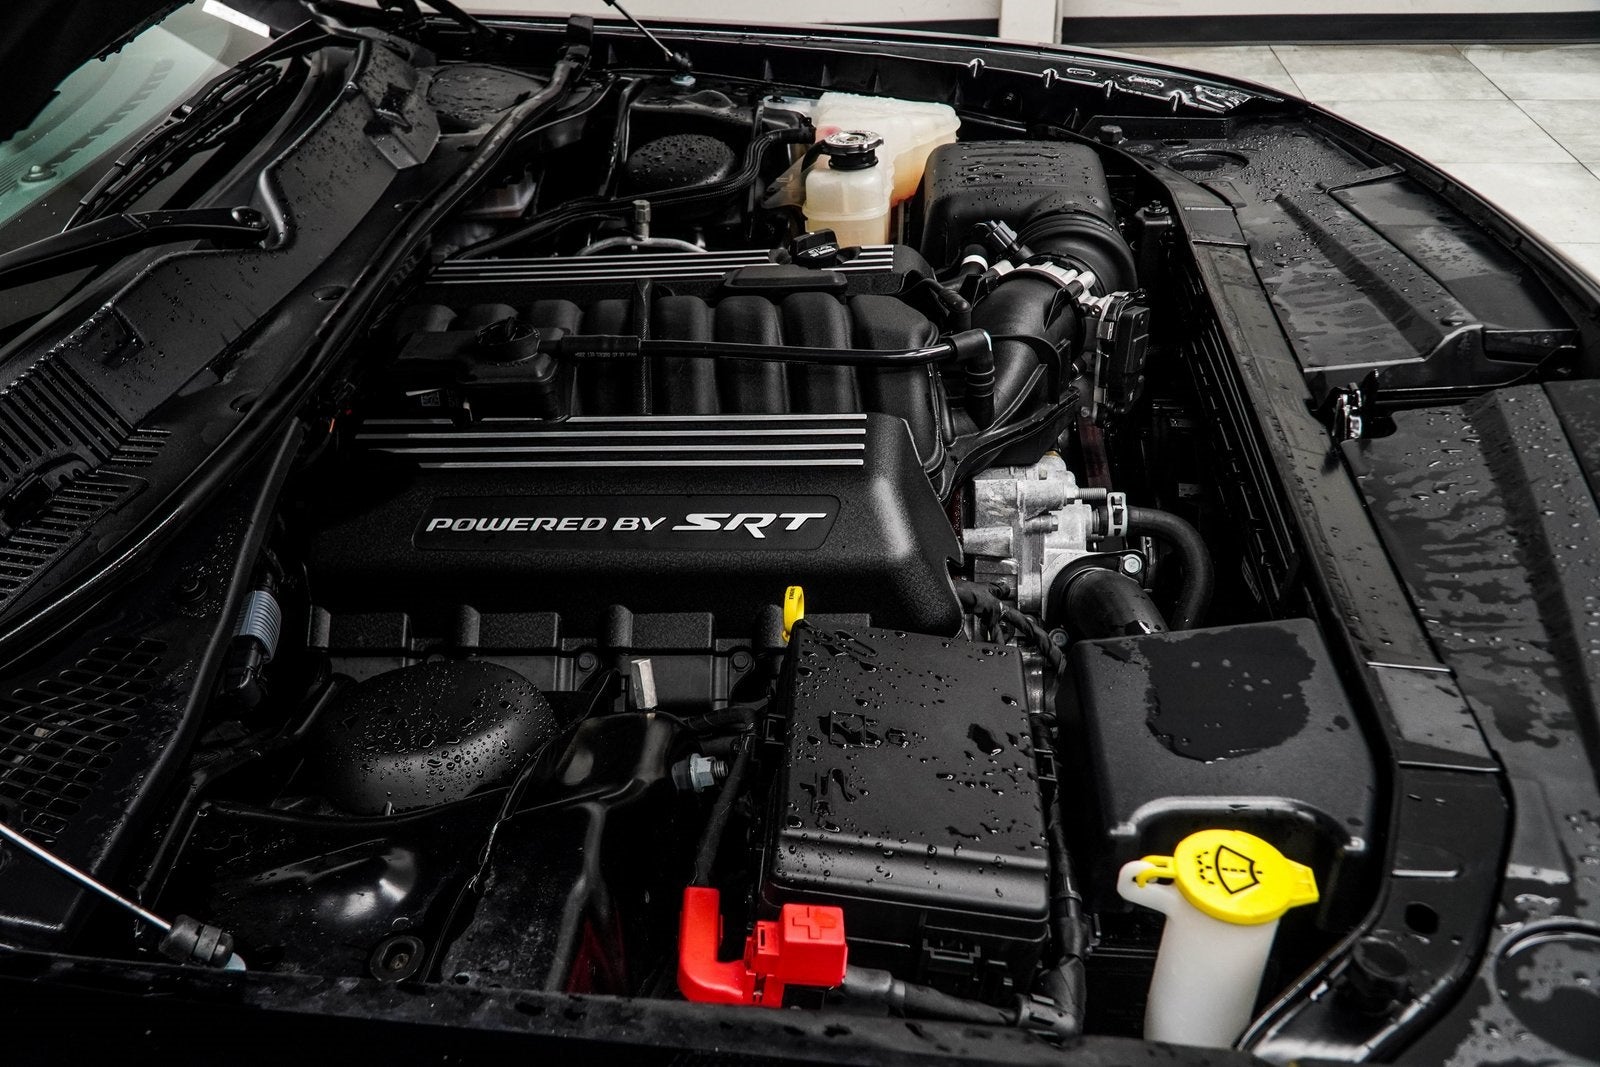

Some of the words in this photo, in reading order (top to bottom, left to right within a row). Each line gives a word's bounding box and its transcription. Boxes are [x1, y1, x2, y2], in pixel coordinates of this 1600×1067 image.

[425, 517, 608, 532] POWERED
[612, 516, 667, 531] BY
[671, 512, 828, 539] SRT
